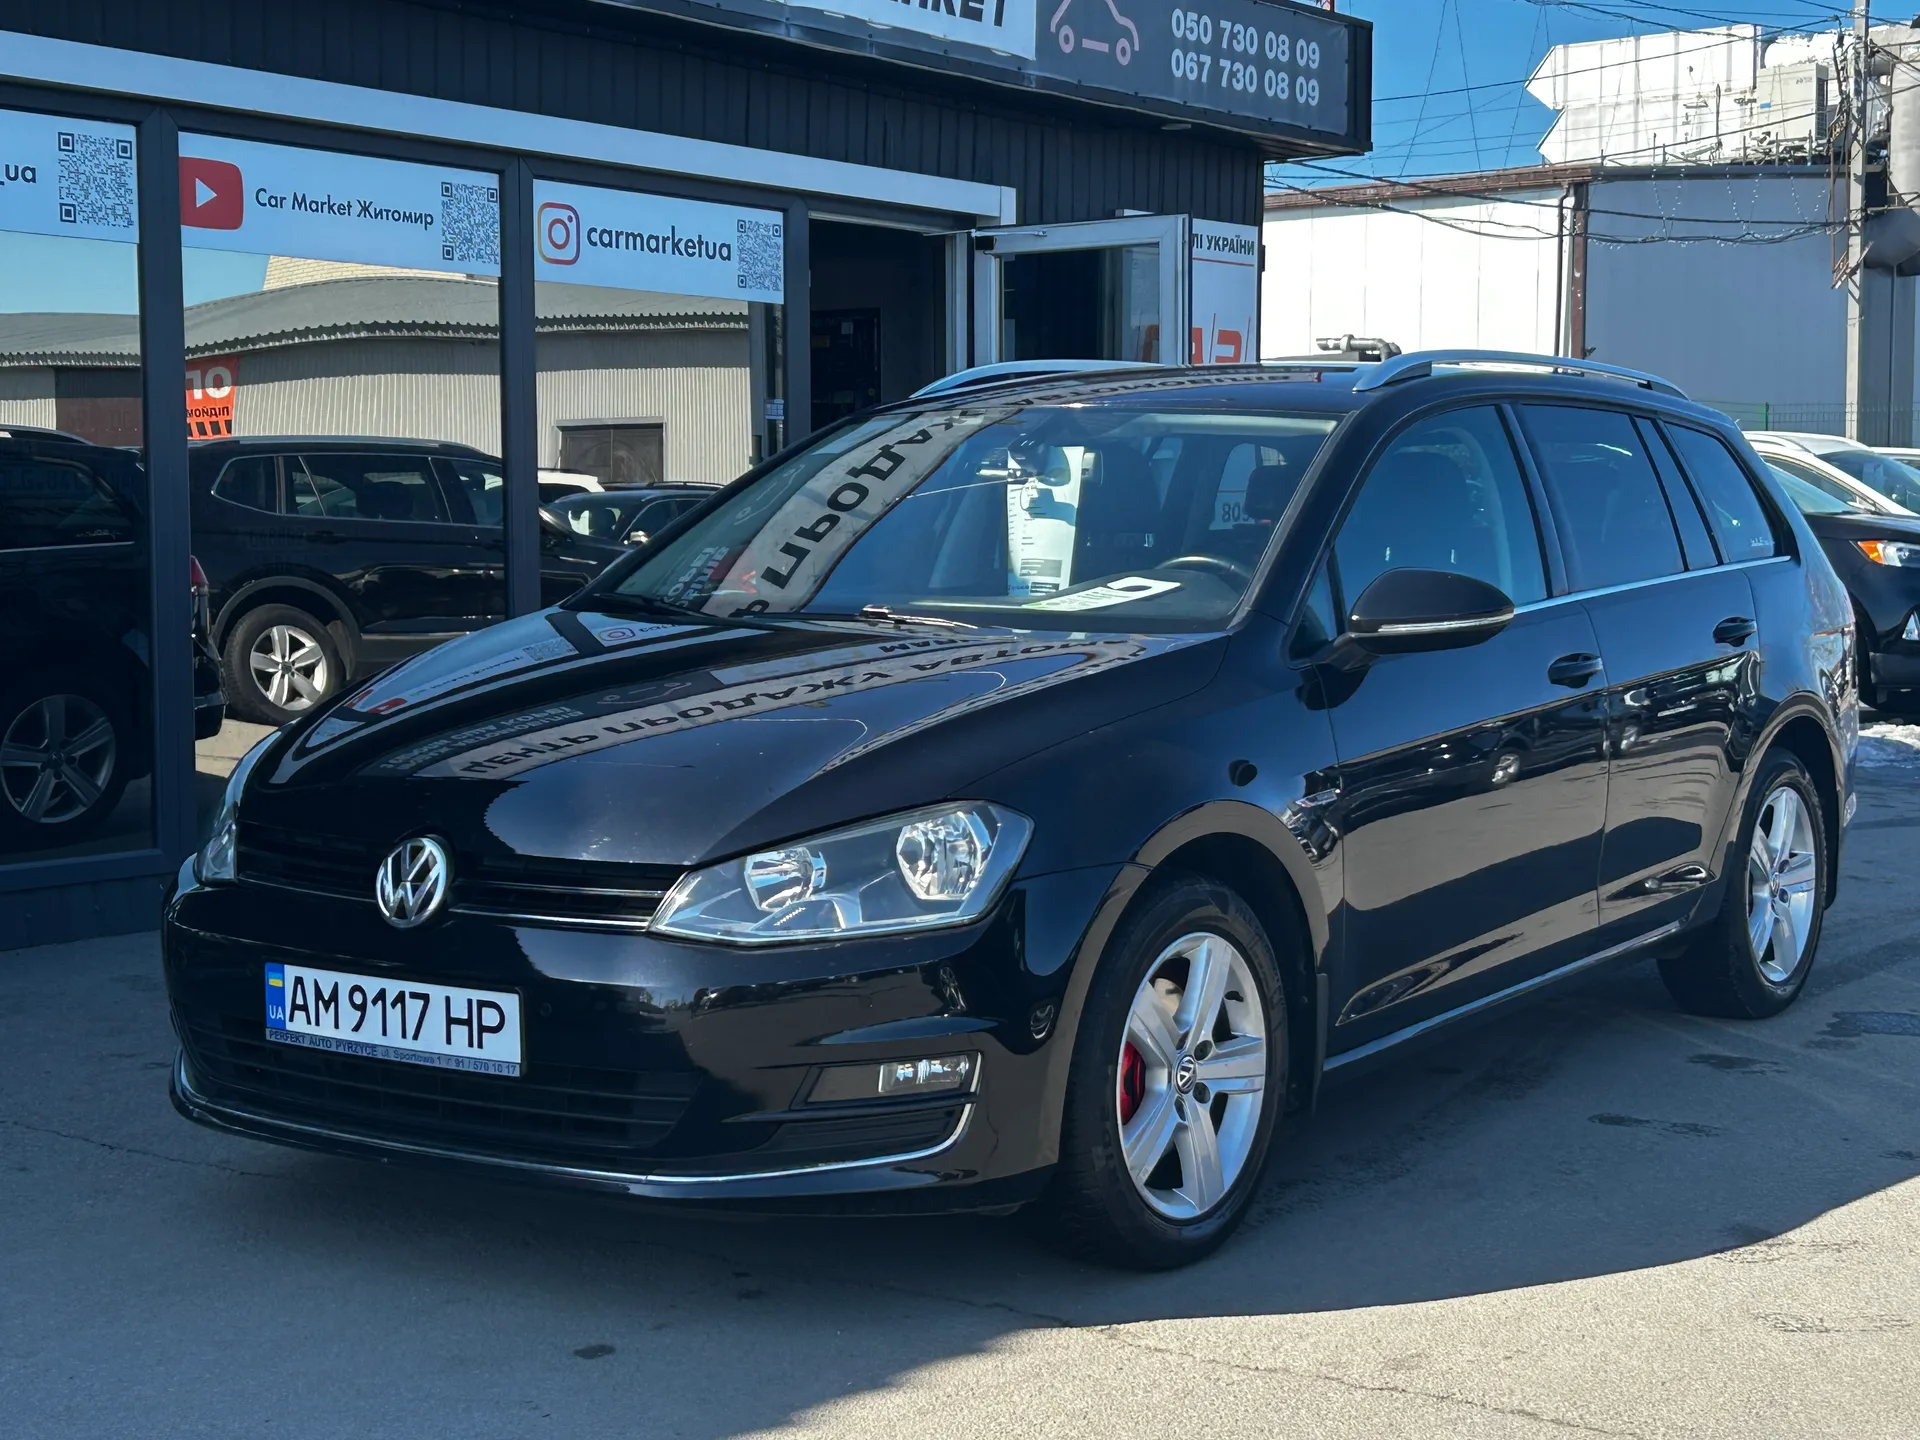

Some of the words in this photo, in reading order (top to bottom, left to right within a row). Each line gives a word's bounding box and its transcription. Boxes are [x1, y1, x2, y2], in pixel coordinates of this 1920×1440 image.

[1171, 8, 1212, 45] 050
[1220, 20, 1258, 55] 730
[1265, 31, 1290, 62] 08
[1296, 38, 1320, 69] 09
[1171, 48, 1211, 83] 067
[1219, 59, 1258, 93] 730
[1264, 69, 1289, 100] 08
[1295, 75, 1319, 106] 09
[255, 187, 287, 209] Car
[291, 191, 352, 217] Market
[357, 199, 434, 231] Житомир
[587, 225, 732, 262] carmarketua
[1207, 234, 1255, 256] УКРАЇНИ
[268, 1004, 285, 1021] UA
[288, 975, 340, 1030] AM
[348, 984, 431, 1041] 9117
[445, 995, 506, 1050] HP
[269, 1029, 306, 1045] PERFEKT
[308, 1038, 332, 1049] AUTO
[335, 1040, 379, 1057] PYRZYCE
[506, 1064, 517, 1075] 17
